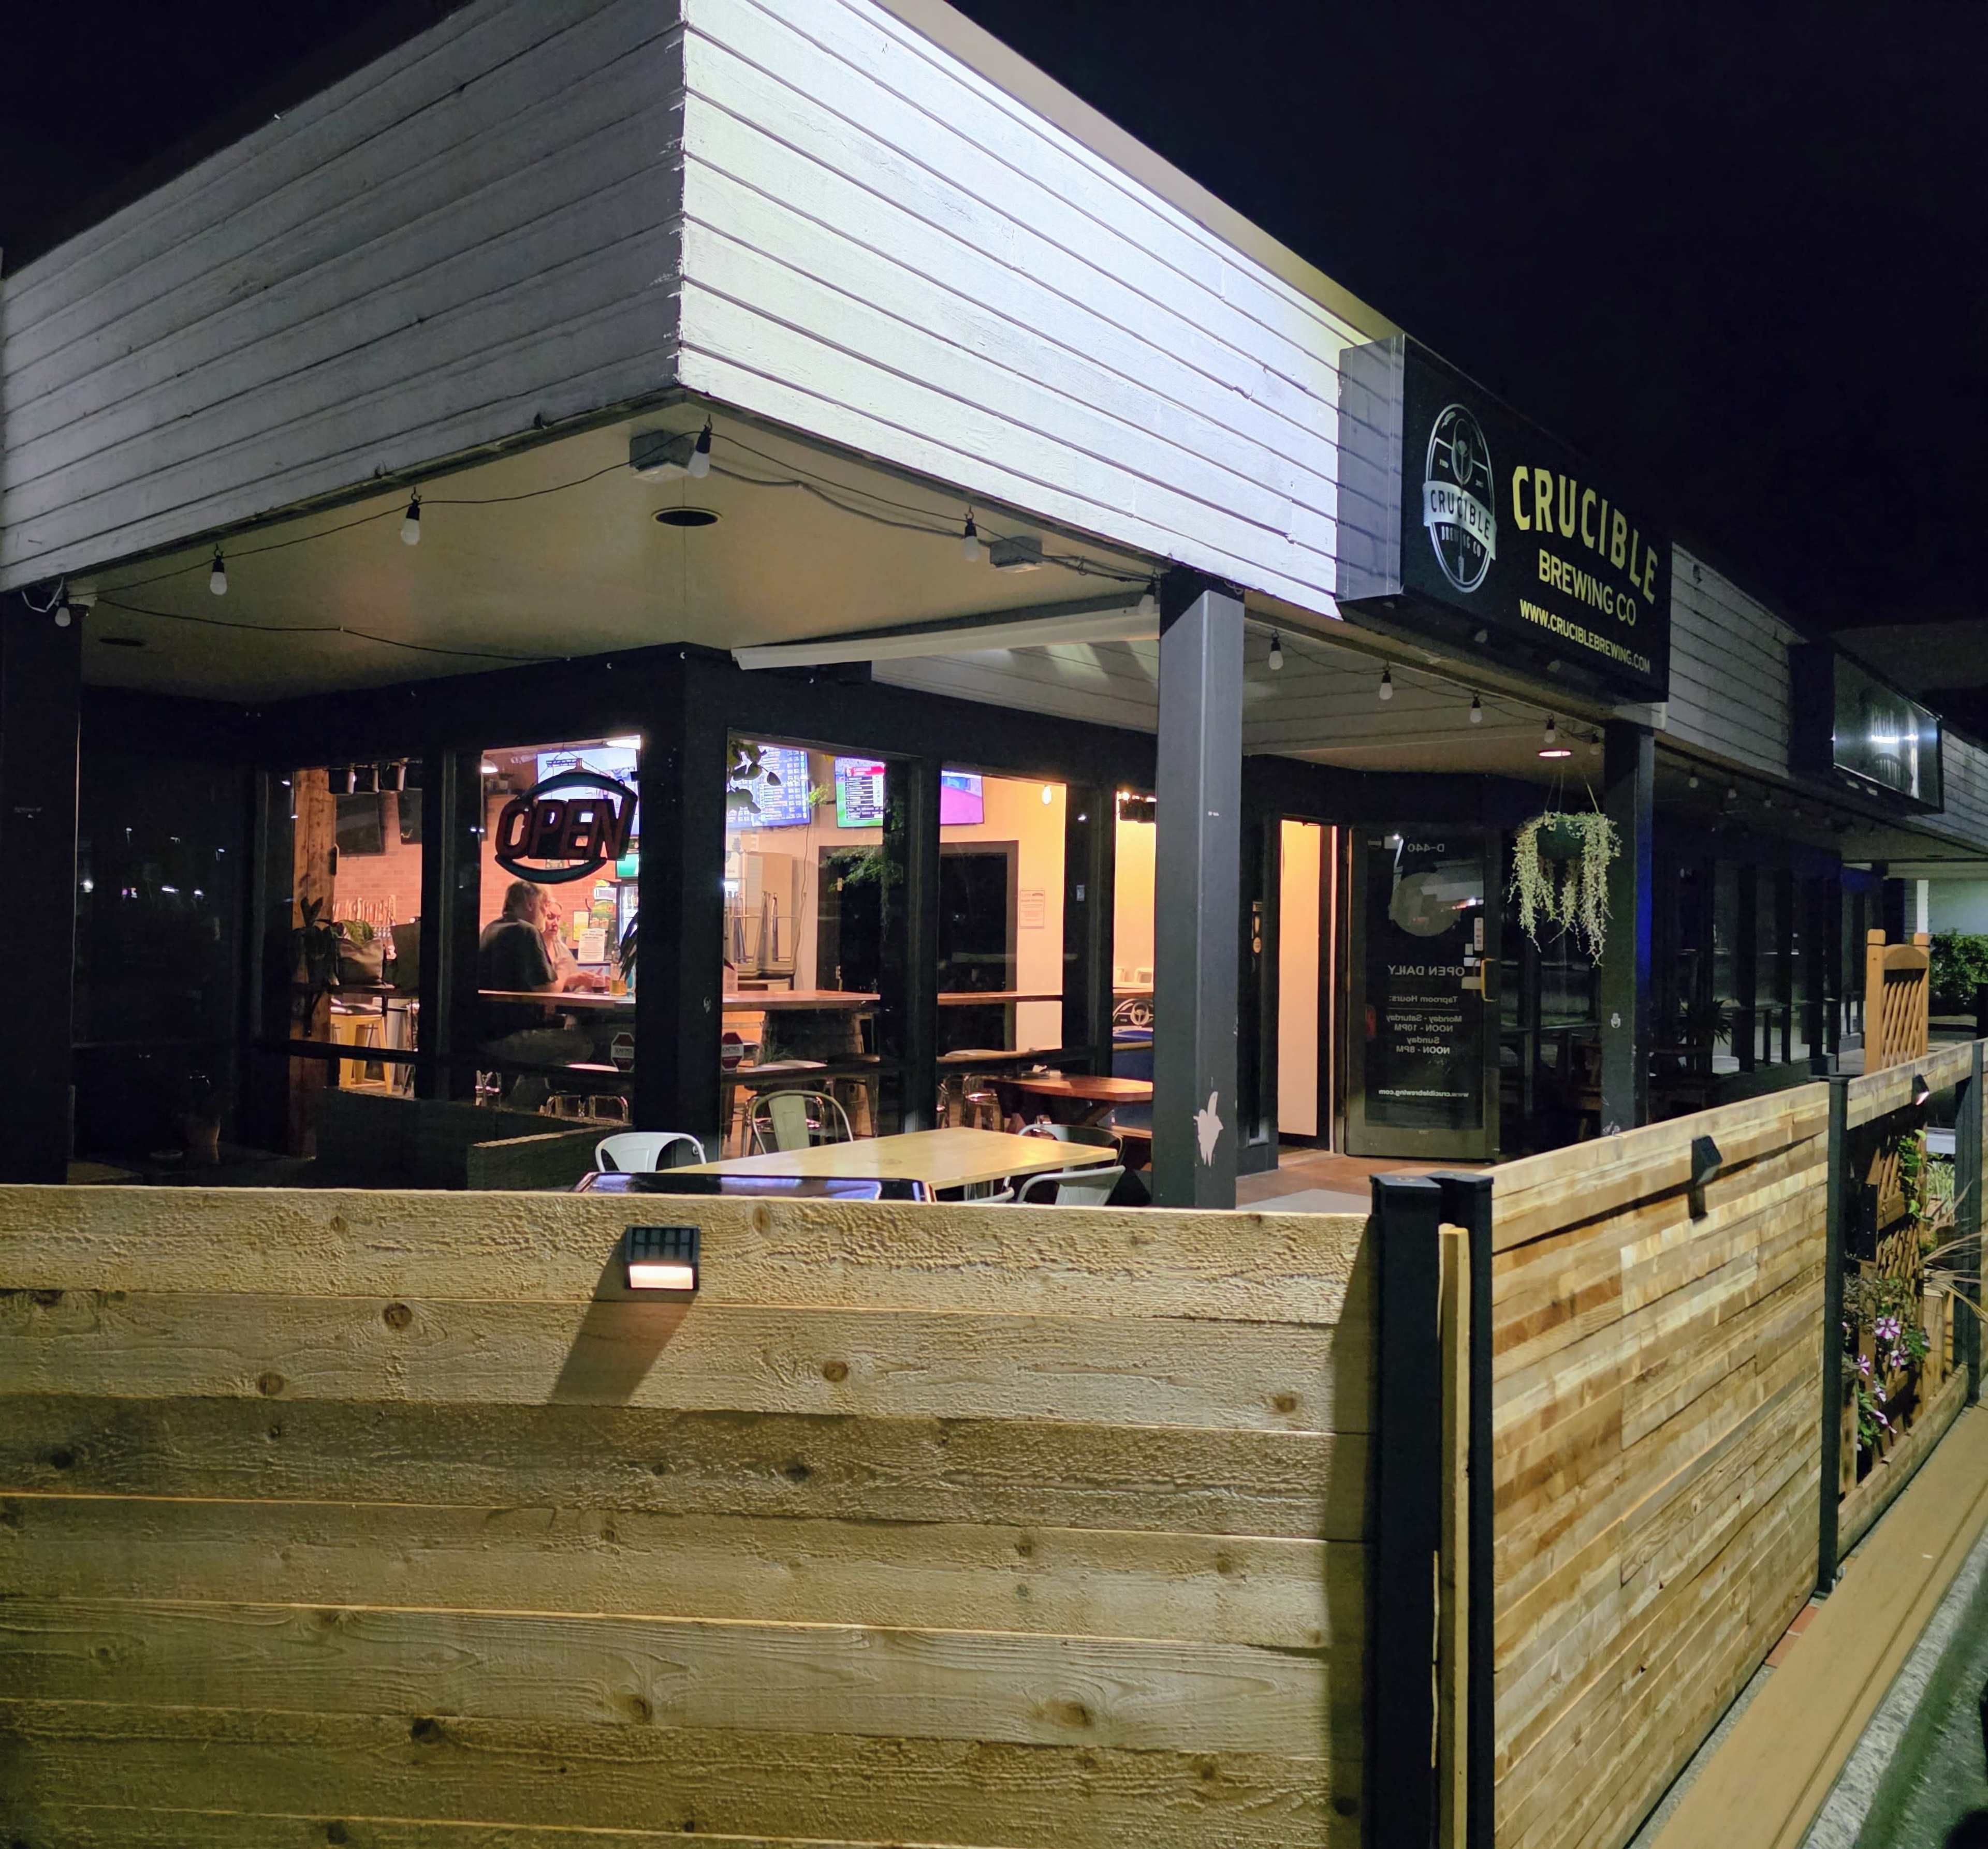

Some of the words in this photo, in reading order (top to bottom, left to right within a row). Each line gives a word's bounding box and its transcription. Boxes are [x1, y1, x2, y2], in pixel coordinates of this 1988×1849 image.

[1430, 490, 1490, 540] CRUCIBLE
[1441, 525, 1471, 549] BREWNG
[1473, 541, 1481, 557] CO
[1512, 466, 1658, 604] CRUCIBLE
[1539, 549, 1614, 614] BREWING
[1617, 593, 1636, 626] CO
[1519, 598, 1650, 673] WWW.CRUCIBLEBREWING.COM
[495, 795, 637, 861] OPEN
